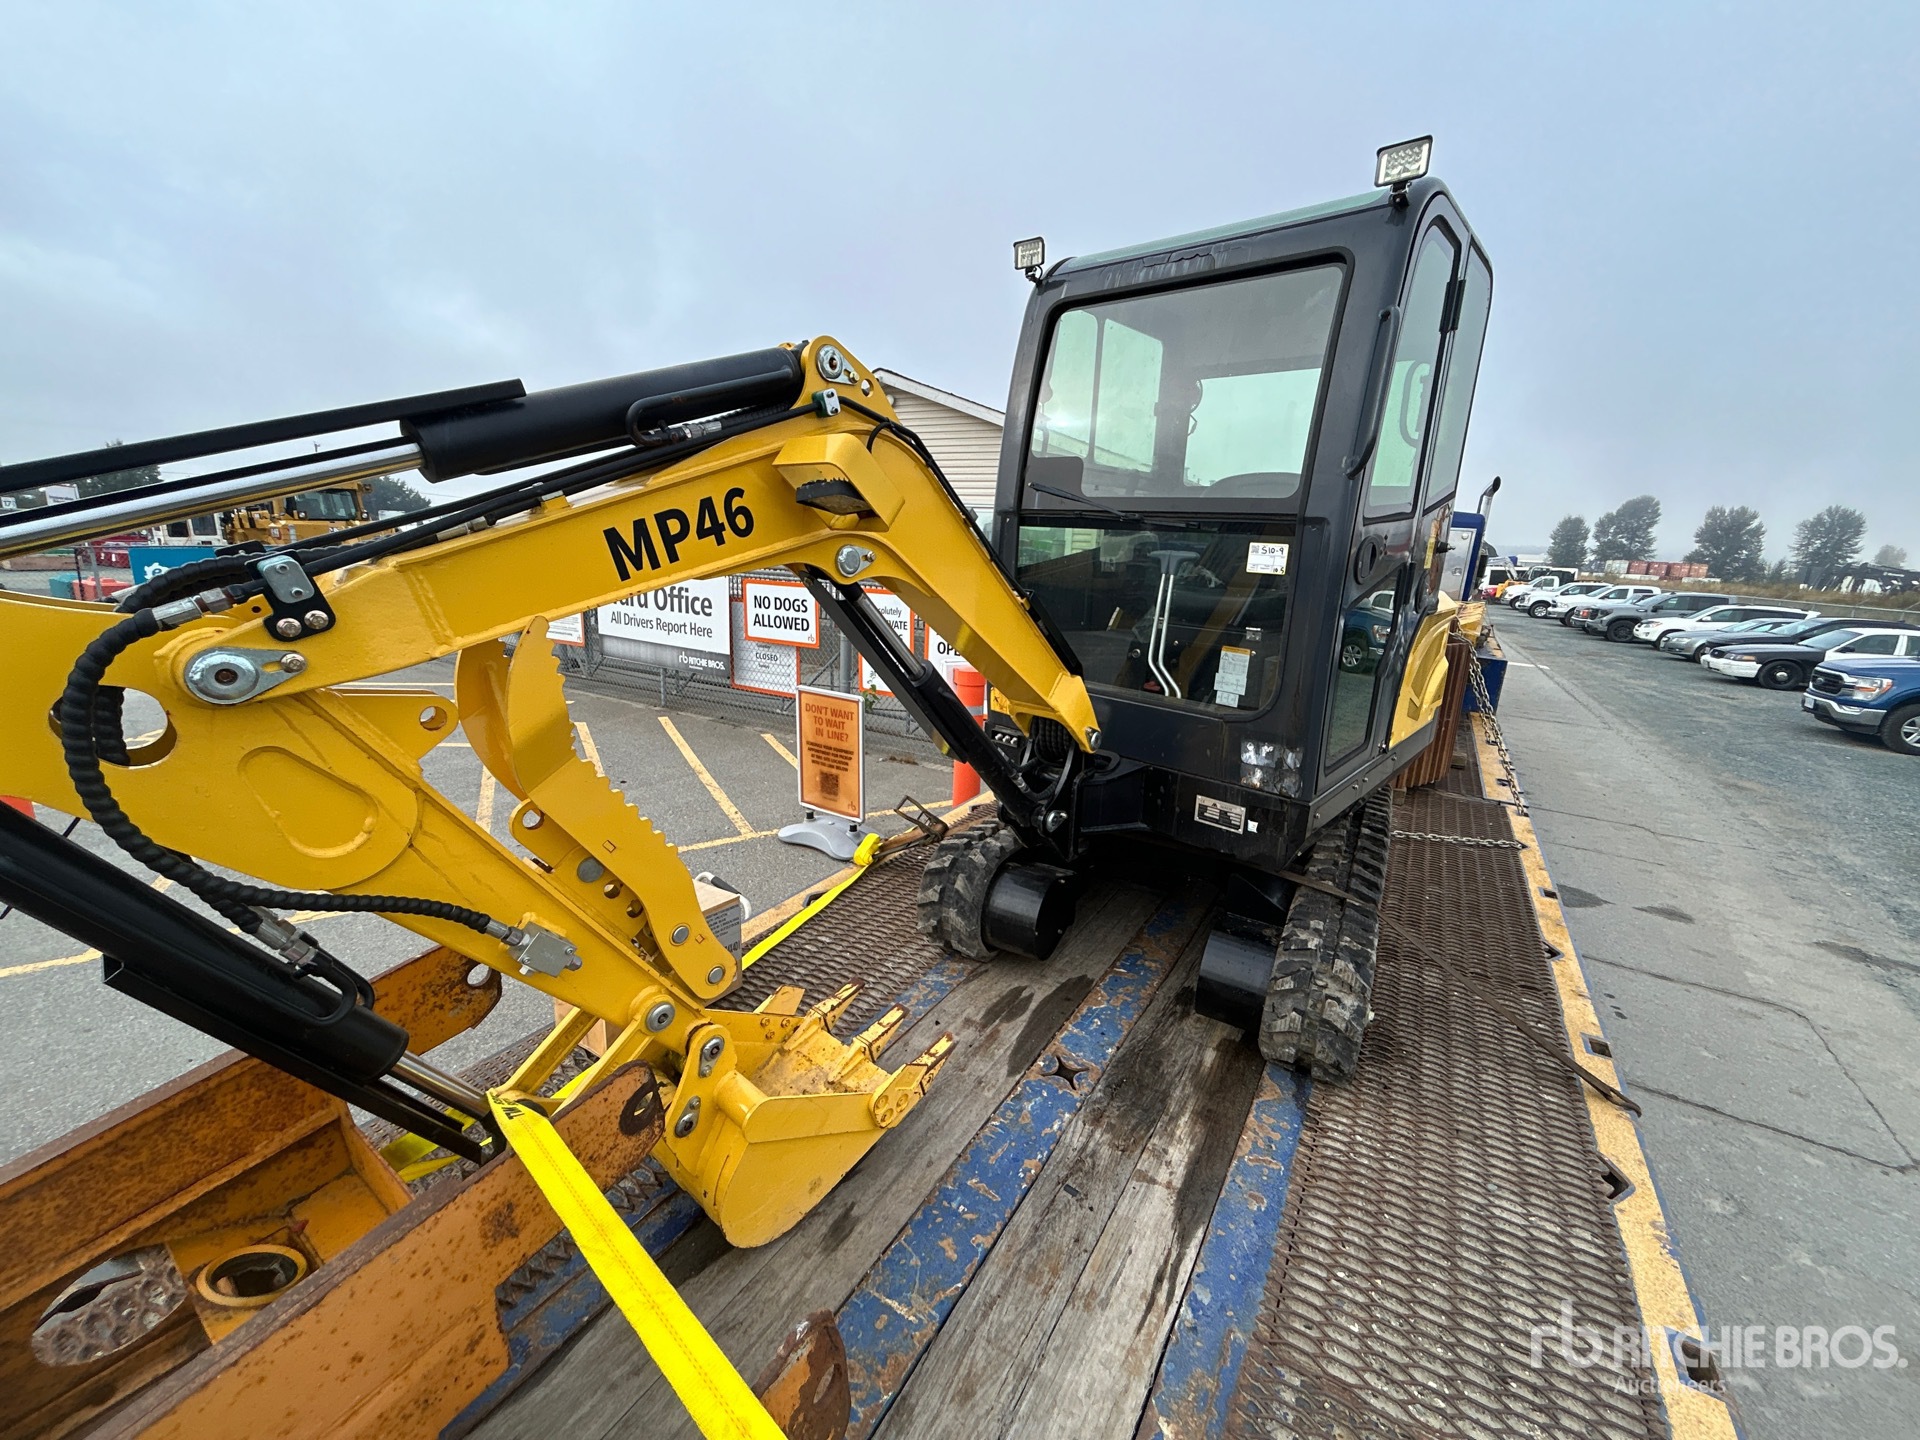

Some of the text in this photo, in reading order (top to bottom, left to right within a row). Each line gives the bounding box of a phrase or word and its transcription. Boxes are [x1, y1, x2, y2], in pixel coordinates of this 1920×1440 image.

[603, 487, 754, 581] MP46
[654, 586, 712, 617] Office
[754, 595, 808, 613] NO DOGS
[611, 611, 713, 638] All Drivers Report Here
[753, 613, 810, 632] ALLOWED
[756, 653, 778, 661] CLOSED
[805, 703, 855, 721] DON'T WANT
[813, 715, 845, 730] TO WAIT
[815, 727, 849, 742] IN LINE?
